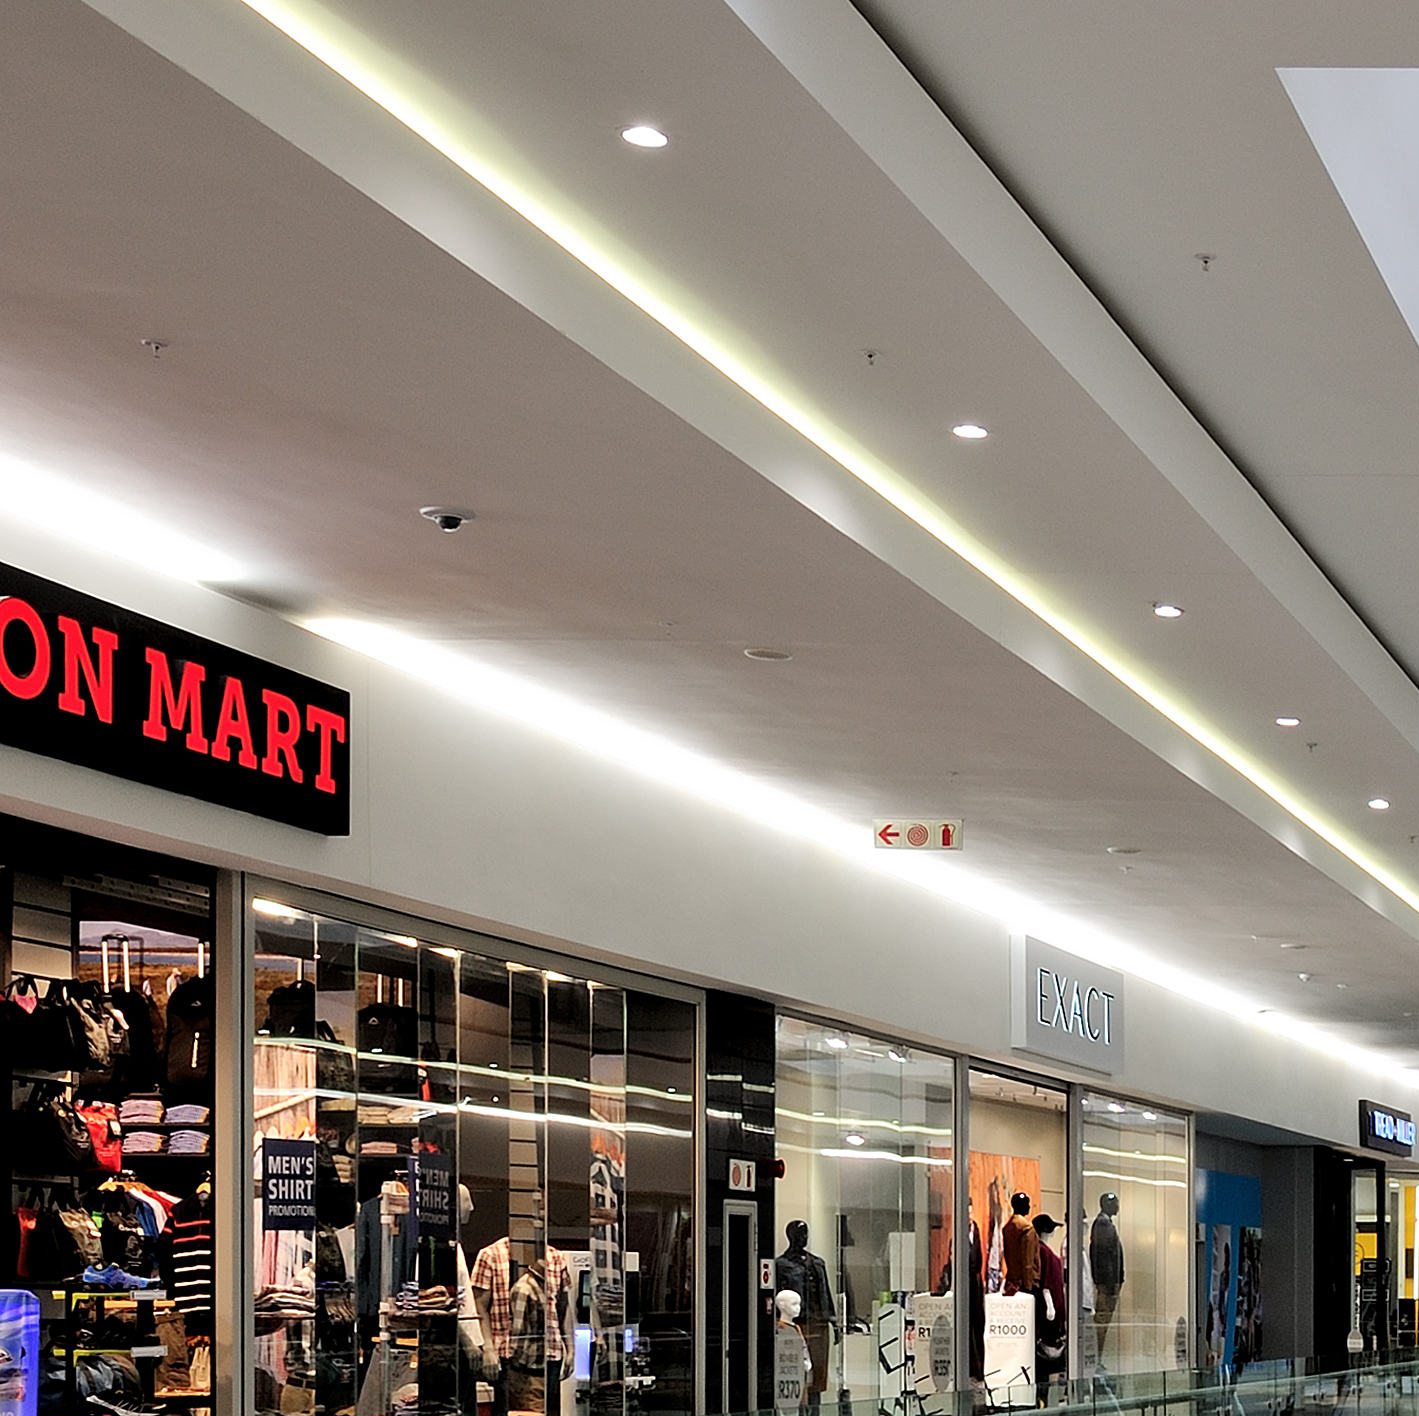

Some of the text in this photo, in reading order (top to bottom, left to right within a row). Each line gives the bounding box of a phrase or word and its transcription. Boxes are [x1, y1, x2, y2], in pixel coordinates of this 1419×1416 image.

[0, 596, 346, 794] ON MART
[1037, 967, 1115, 1045] EXACT
[268, 1155, 314, 1175] MEN'S
[268, 1179, 314, 1200] SHIRT
[268, 1204, 315, 1216] PROMOTION
[989, 1325, 1027, 1335] R1000
[779, 1380, 800, 1398] R370
